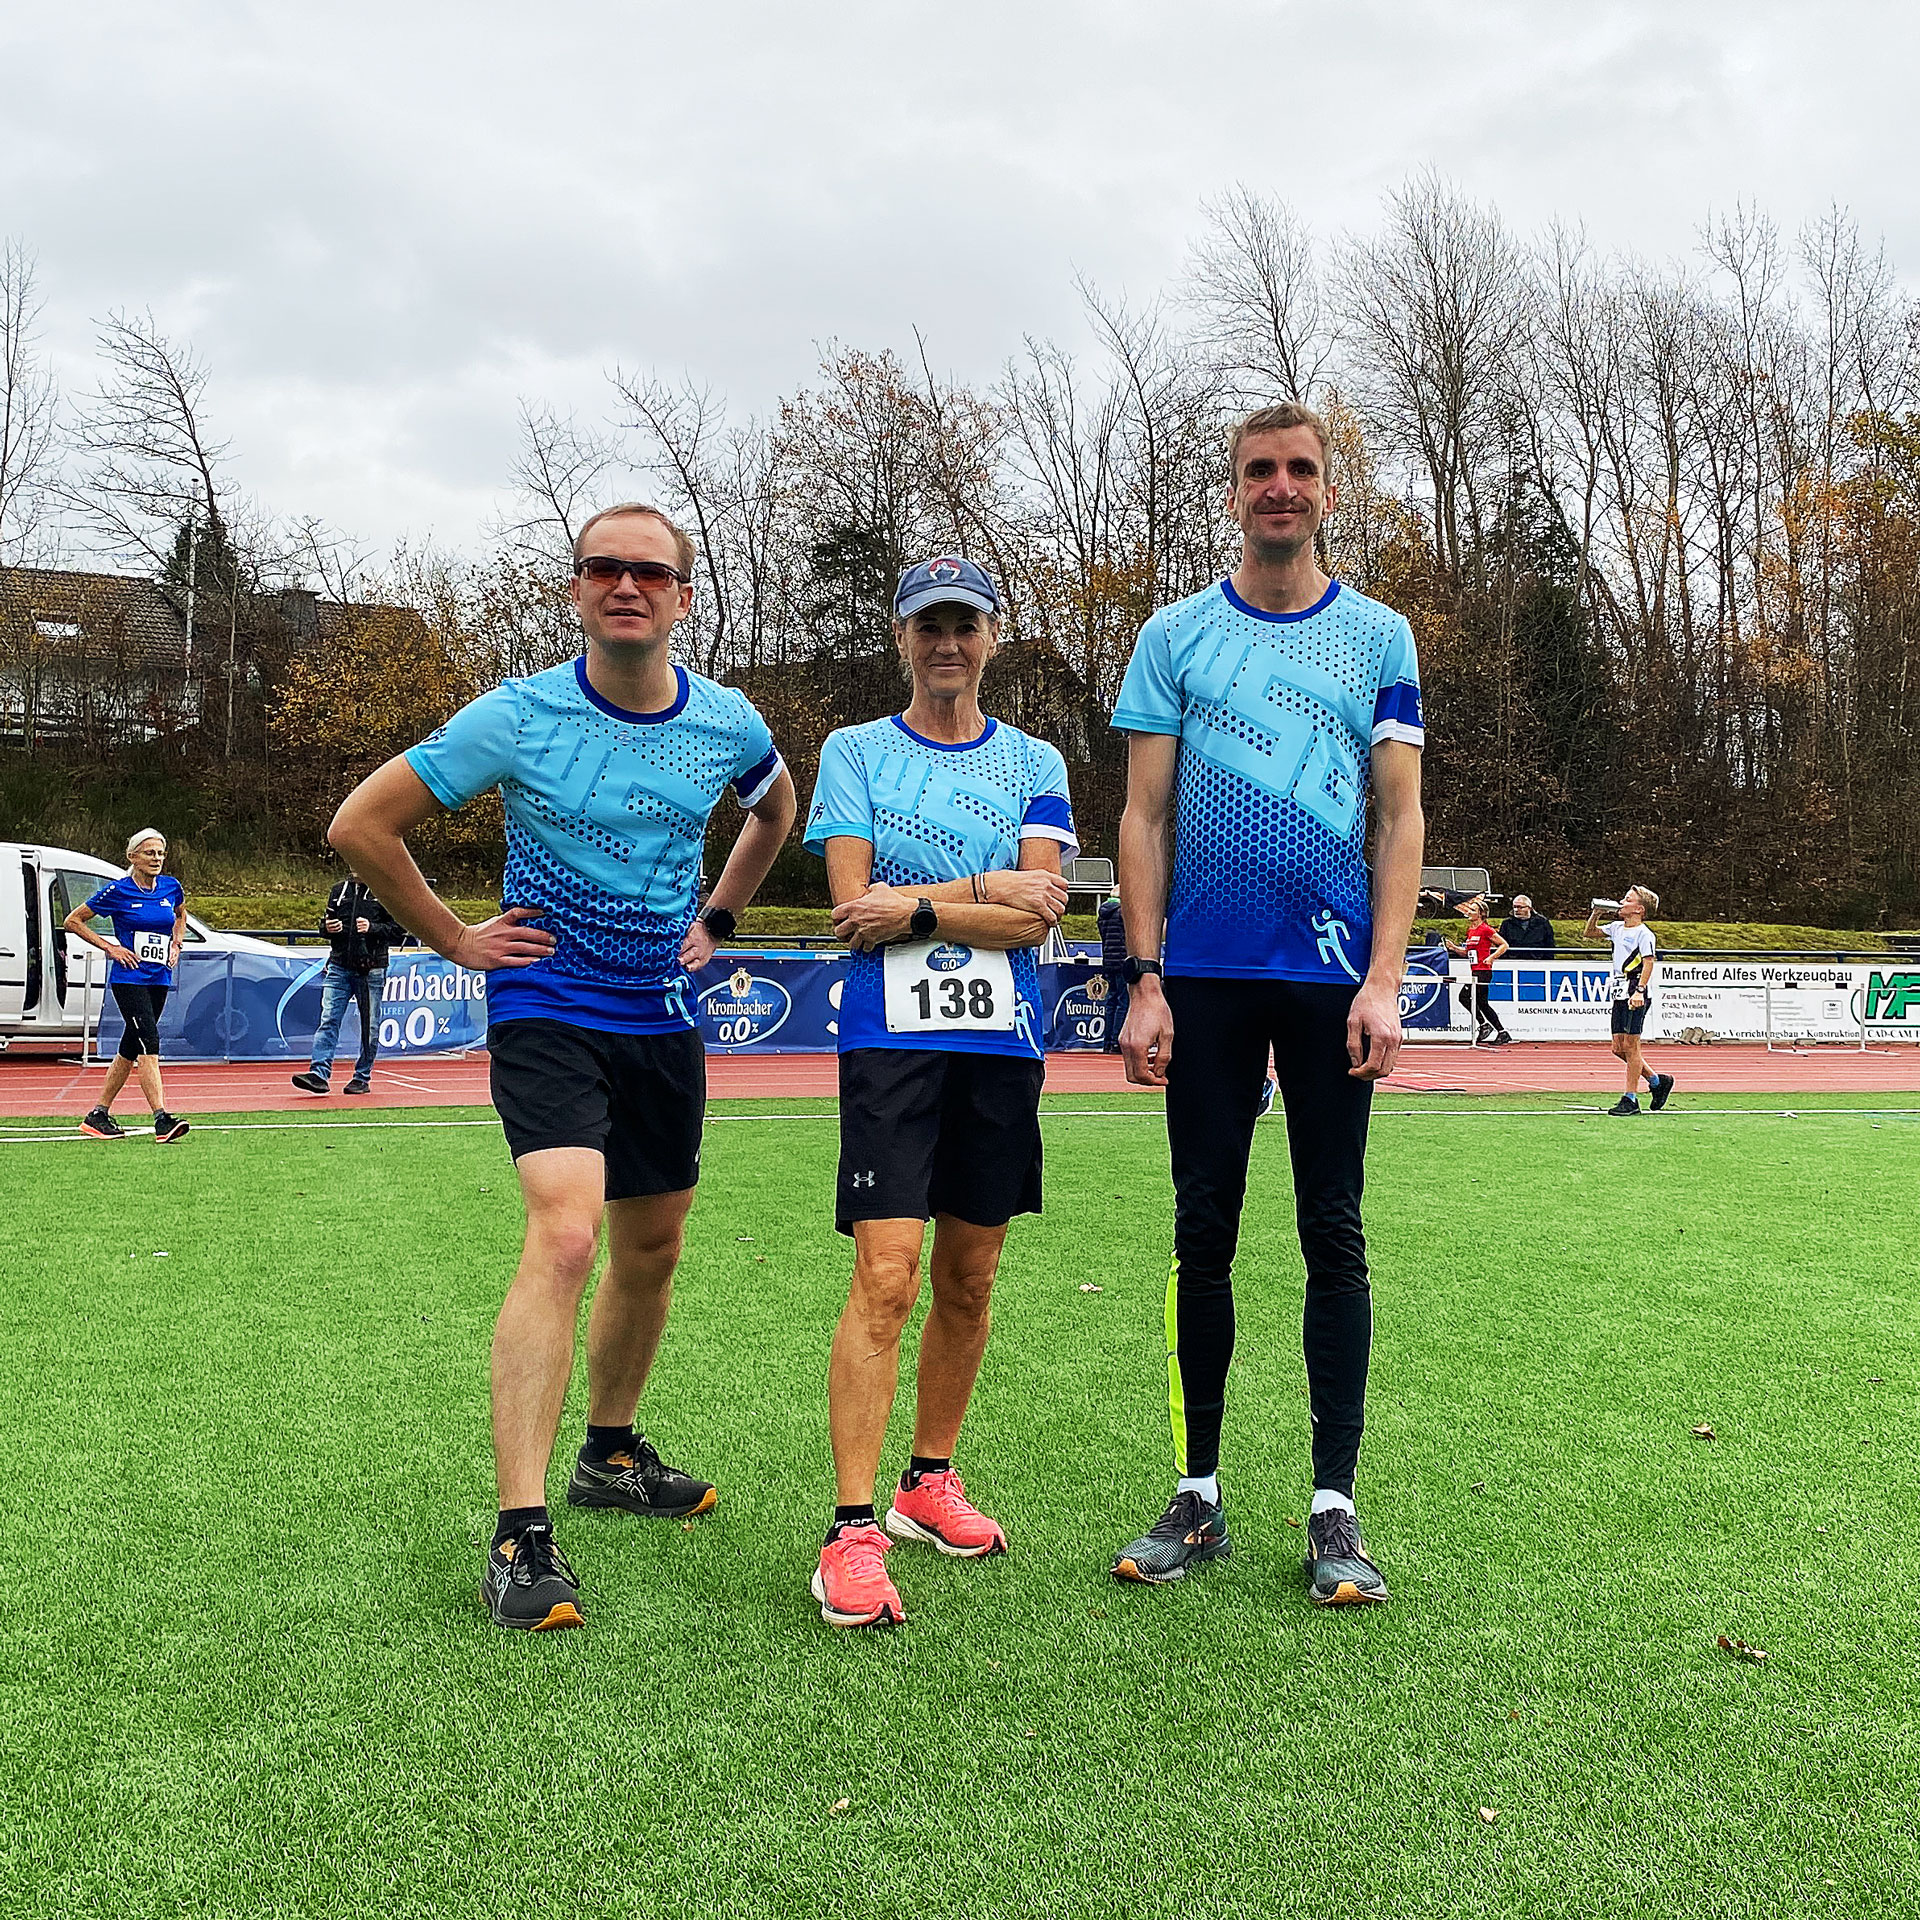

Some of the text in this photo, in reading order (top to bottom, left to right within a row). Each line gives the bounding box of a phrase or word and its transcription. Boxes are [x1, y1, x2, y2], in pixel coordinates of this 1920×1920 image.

[140, 945, 164, 961] 605
[382, 963, 487, 1002] mbache
[1662, 967, 1852, 983] Manfred Alfes Werkzeugbau
[1398, 982, 1428, 995] acher
[706, 997, 774, 1016] Krombacher
[910, 978, 995, 1020] 138
[1065, 999, 1105, 1016] Kromba
[1569, 1008, 1612, 1016] ANLAGENTEC
[1807, 1028, 1860, 1038] Konstruktion
